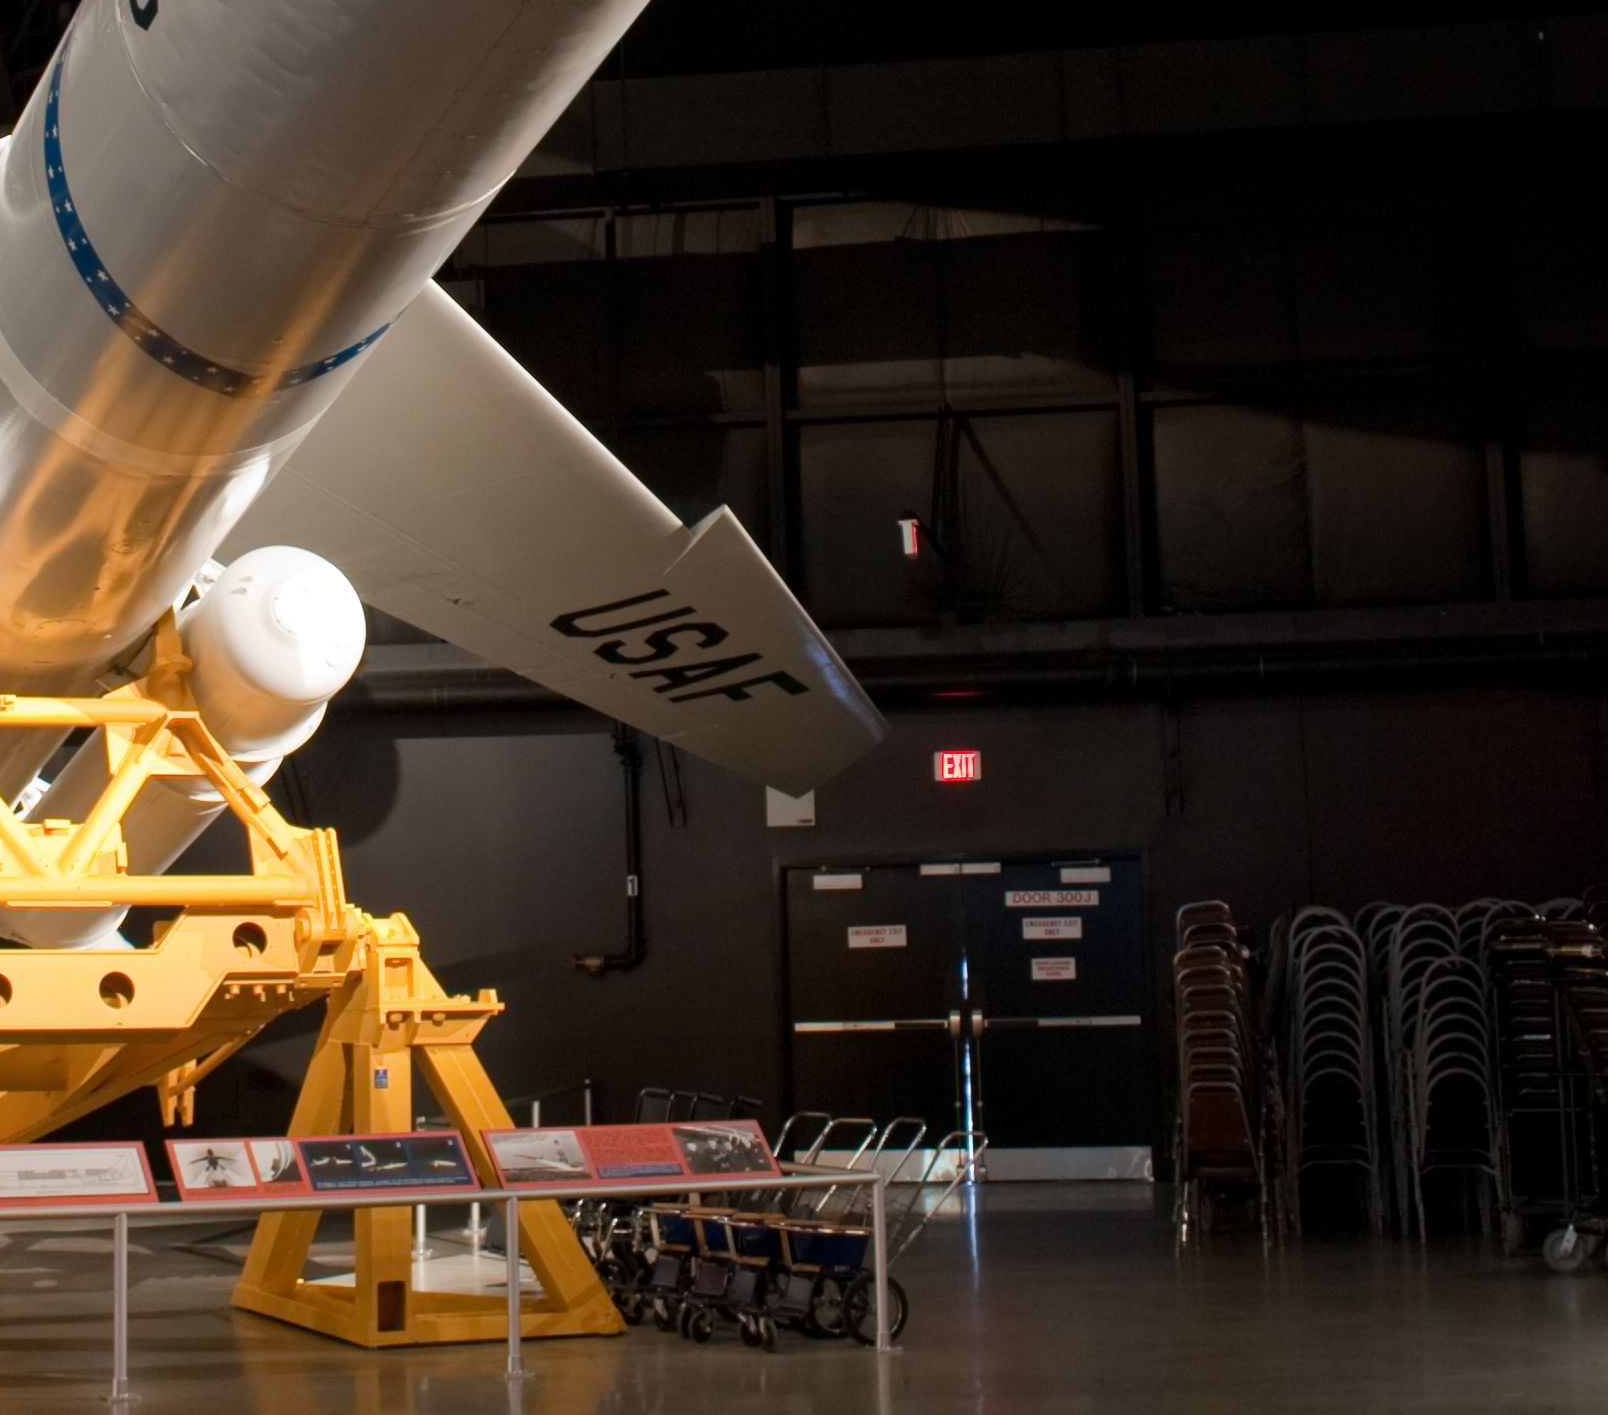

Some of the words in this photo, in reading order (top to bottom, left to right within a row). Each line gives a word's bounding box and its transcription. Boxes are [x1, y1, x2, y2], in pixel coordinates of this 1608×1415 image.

[549, 588, 811, 704] USAF
[943, 754, 976, 779] EXIT
[1013, 893, 1051, 903] DOOR
[1057, 892, 1091, 903] 300J
